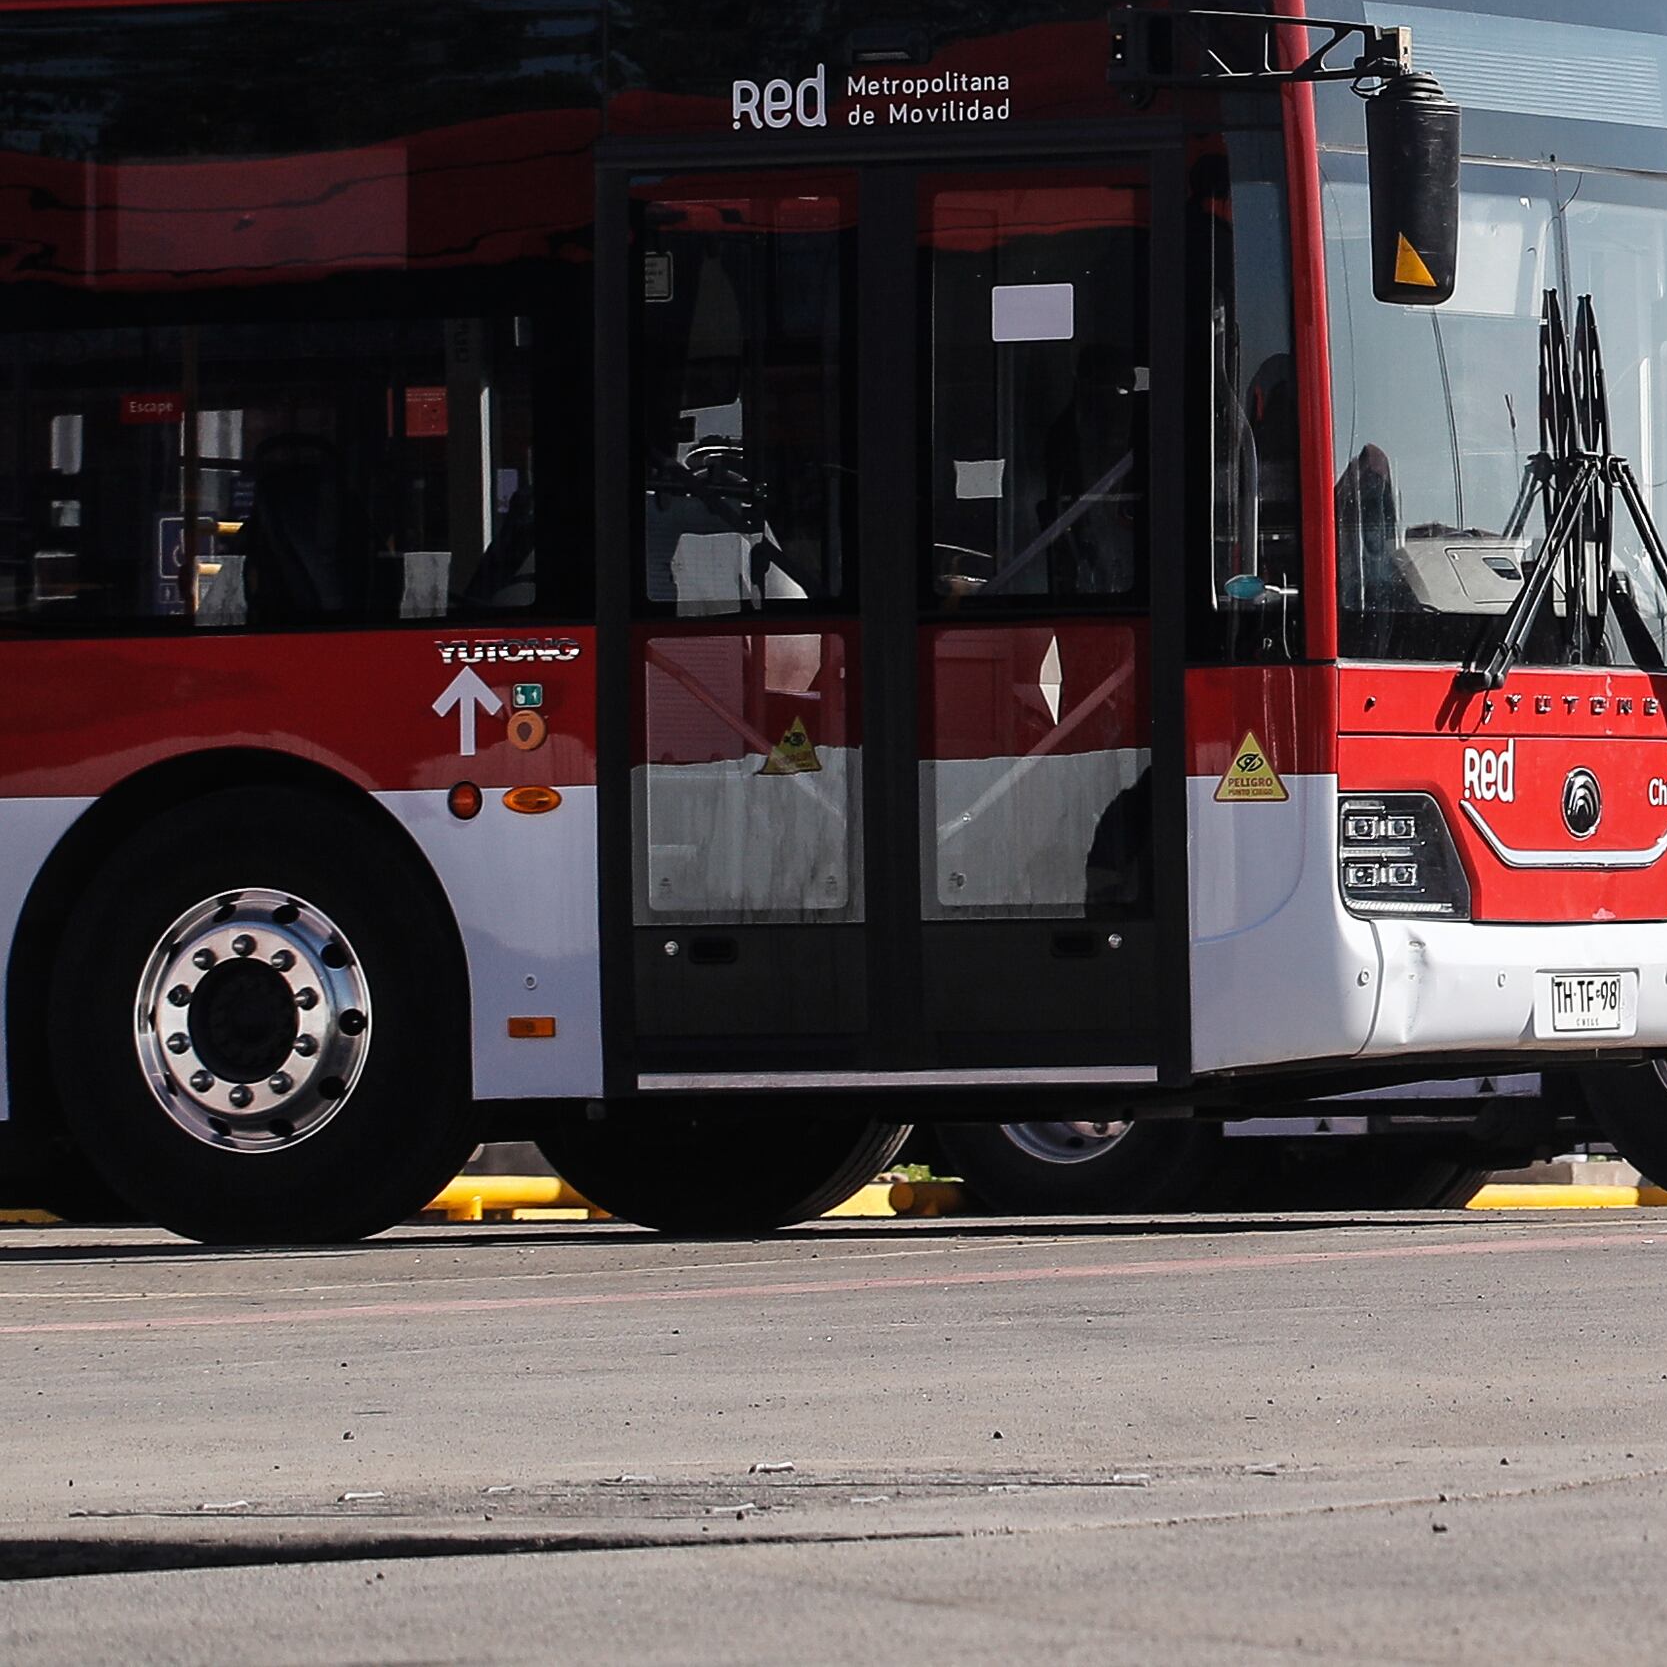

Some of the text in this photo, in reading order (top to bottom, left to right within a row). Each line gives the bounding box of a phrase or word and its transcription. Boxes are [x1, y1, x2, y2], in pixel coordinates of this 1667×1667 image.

[732, 63, 827, 130] Red
[848, 71, 1009, 99] Metropolitana
[848, 98, 1010, 126] de Movilidad
[128, 400, 174, 413] Escape
[433, 637, 581, 663] YUTONG
[1228, 777, 1273, 788] PELIGRO
[1463, 738, 1516, 803] Red
